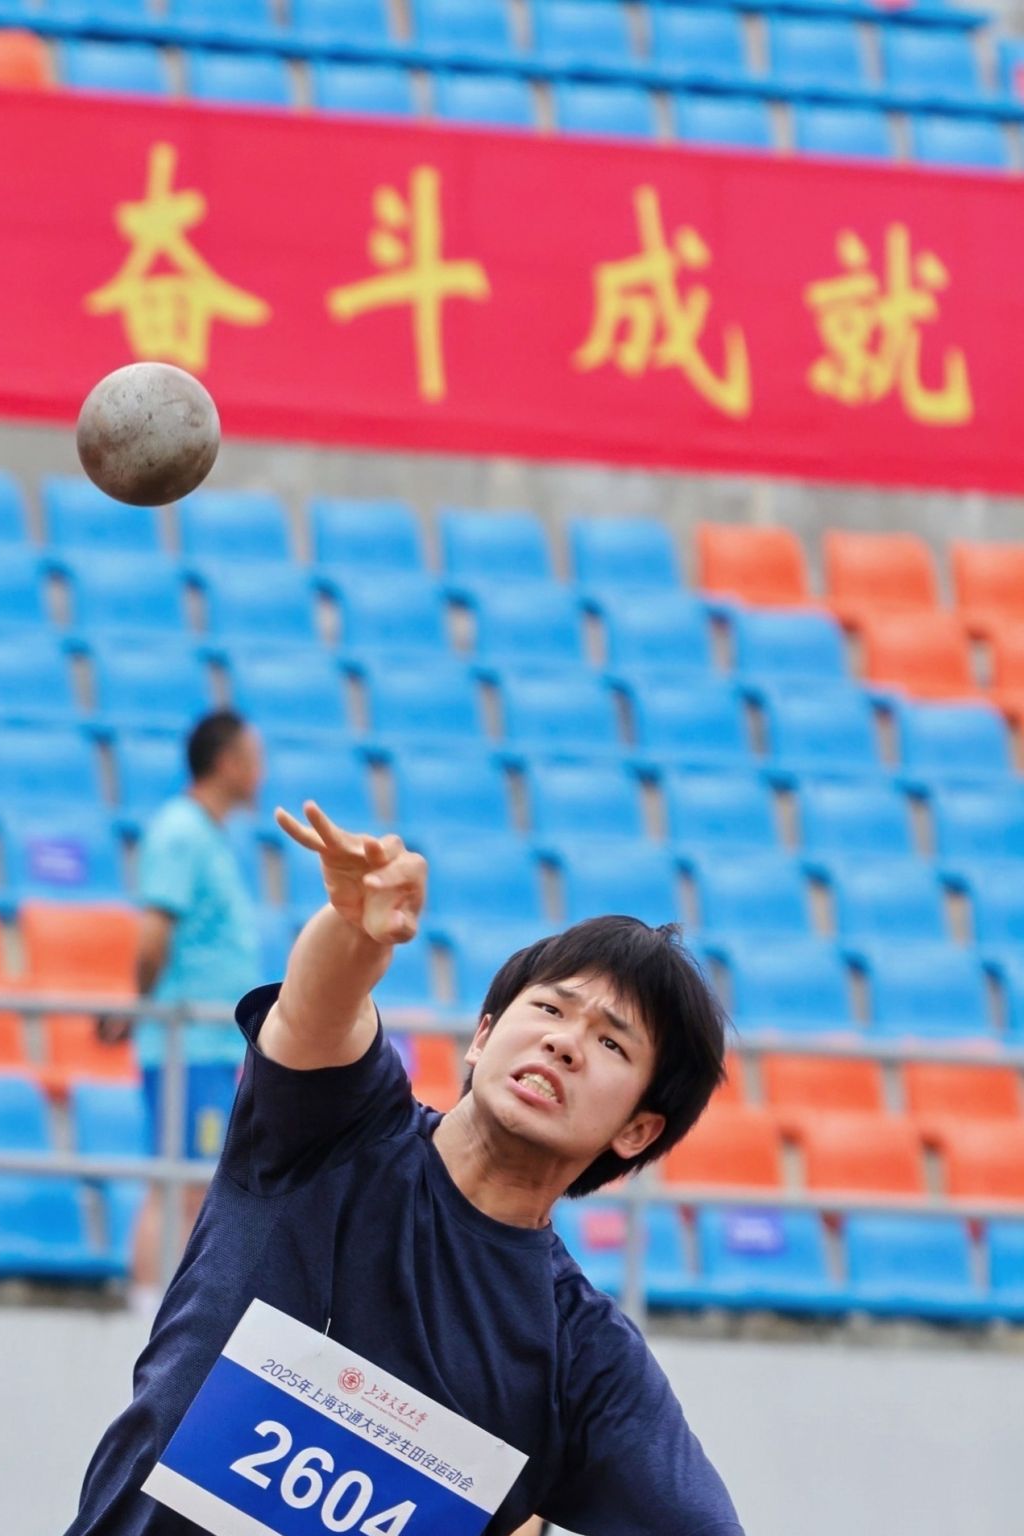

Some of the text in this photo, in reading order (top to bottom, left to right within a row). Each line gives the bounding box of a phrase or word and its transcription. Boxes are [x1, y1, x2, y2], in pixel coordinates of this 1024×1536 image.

[84, 142, 973, 425] 奋斗成就
[260, 1358, 475, 1493] 2025年上海交通大学学生田径运动会
